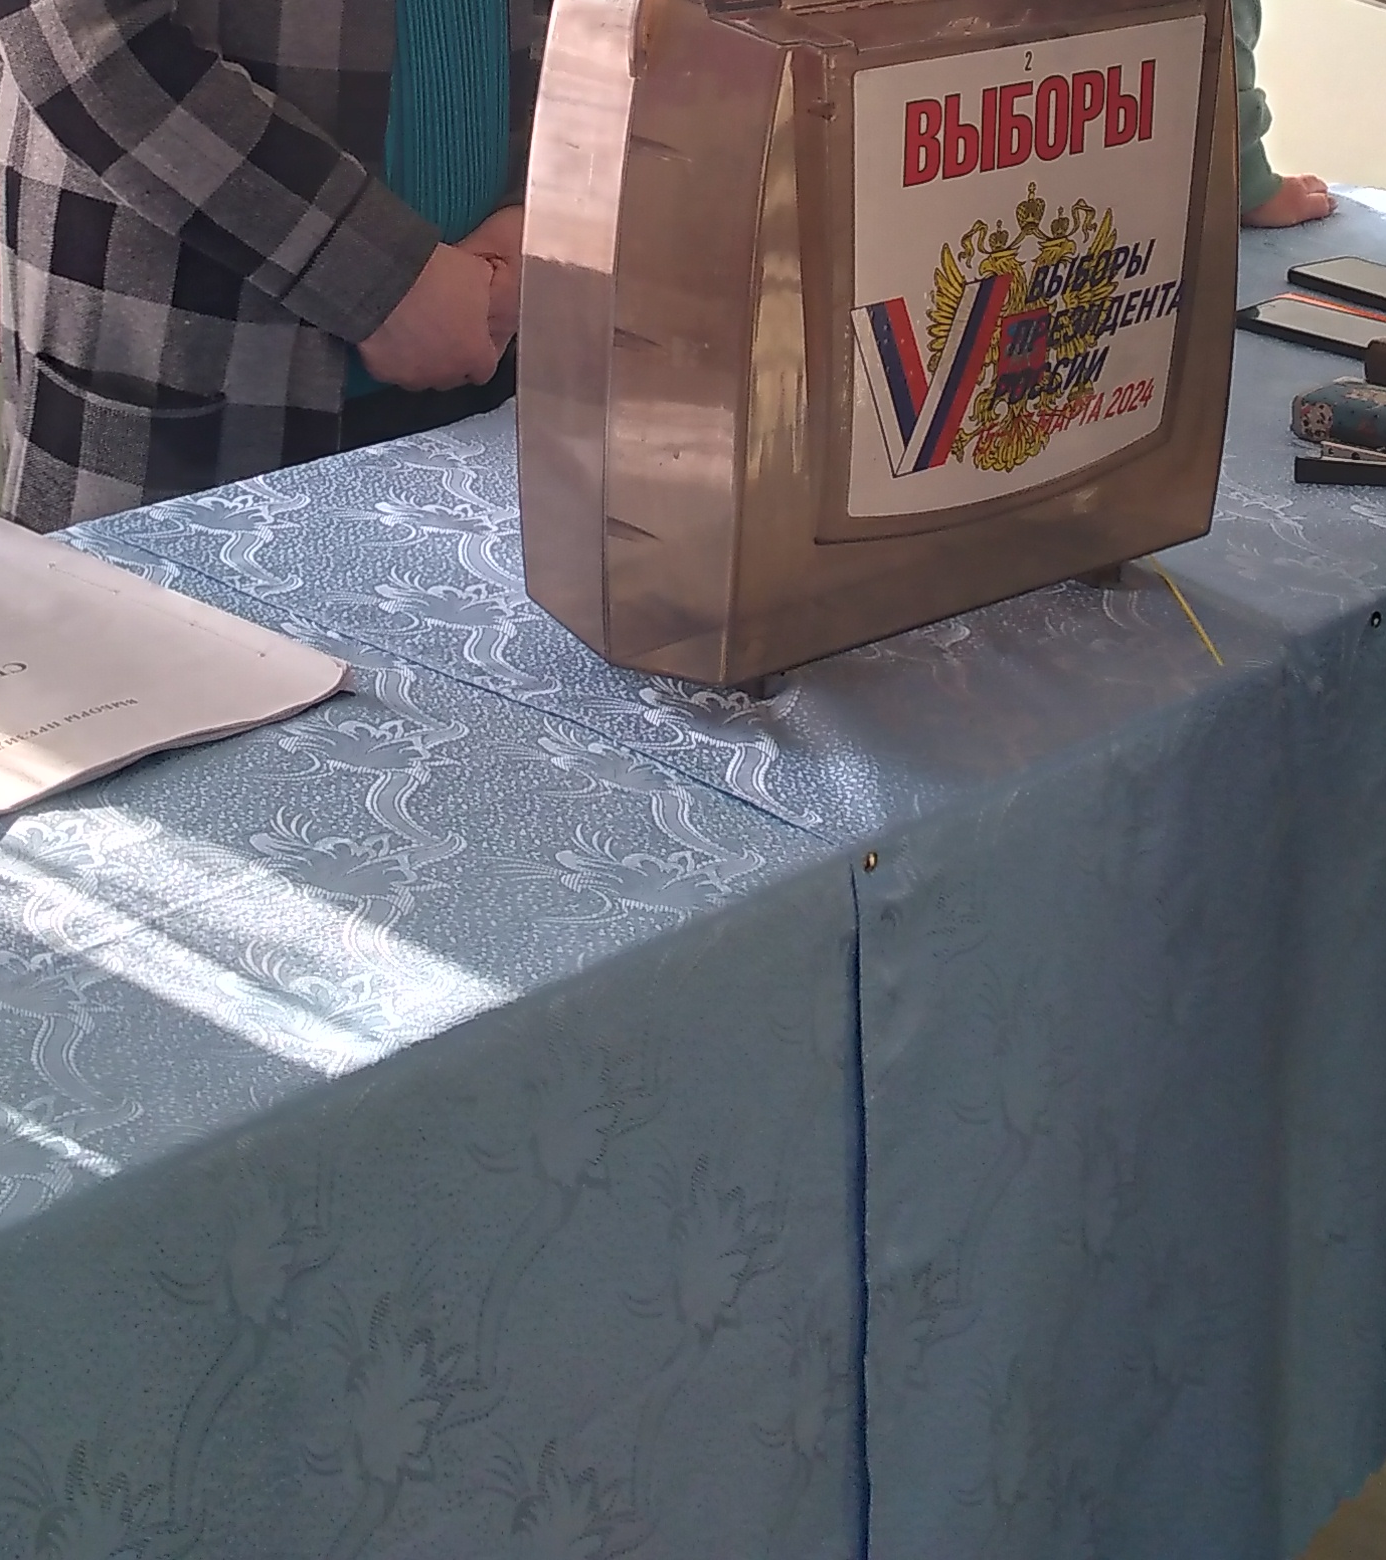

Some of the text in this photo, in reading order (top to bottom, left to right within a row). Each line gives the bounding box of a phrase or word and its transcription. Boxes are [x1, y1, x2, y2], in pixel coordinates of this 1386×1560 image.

[1025, 51, 1033, 72] 2
[903, 59, 1156, 187] ВЫБОРЫ
[1025, 239, 1156, 303] ВЫБОРЫ
[1105, 378, 1154, 420] 2024
[63, 696, 138, 725] ВЫБОРЫ
